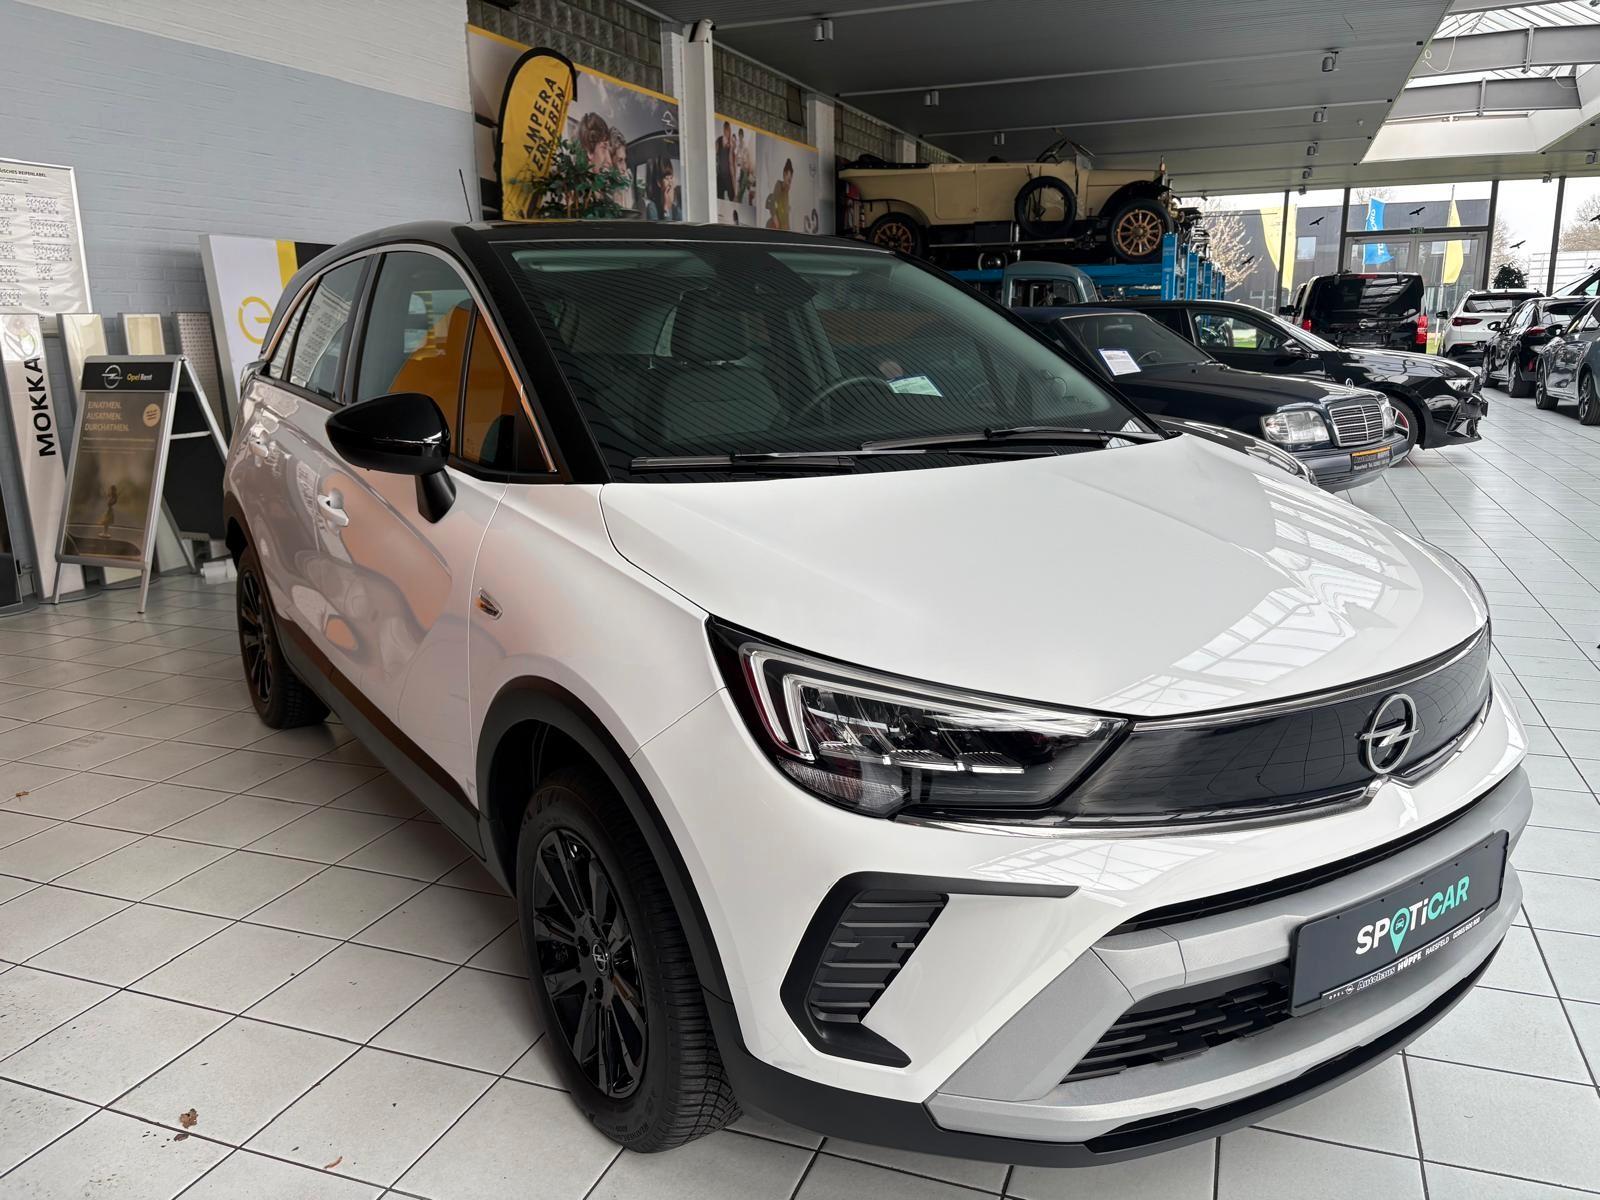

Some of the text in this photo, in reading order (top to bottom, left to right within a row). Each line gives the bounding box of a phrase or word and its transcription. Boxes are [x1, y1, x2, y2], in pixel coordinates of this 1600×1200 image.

[523, 77, 557, 155] AMPERA
[24, 357, 57, 457] MOKKA
[127, 373, 141, 383] Opel
[1357, 967, 1395, 990] Autohaus
[1425, 936, 1450, 956] RAESFELD
